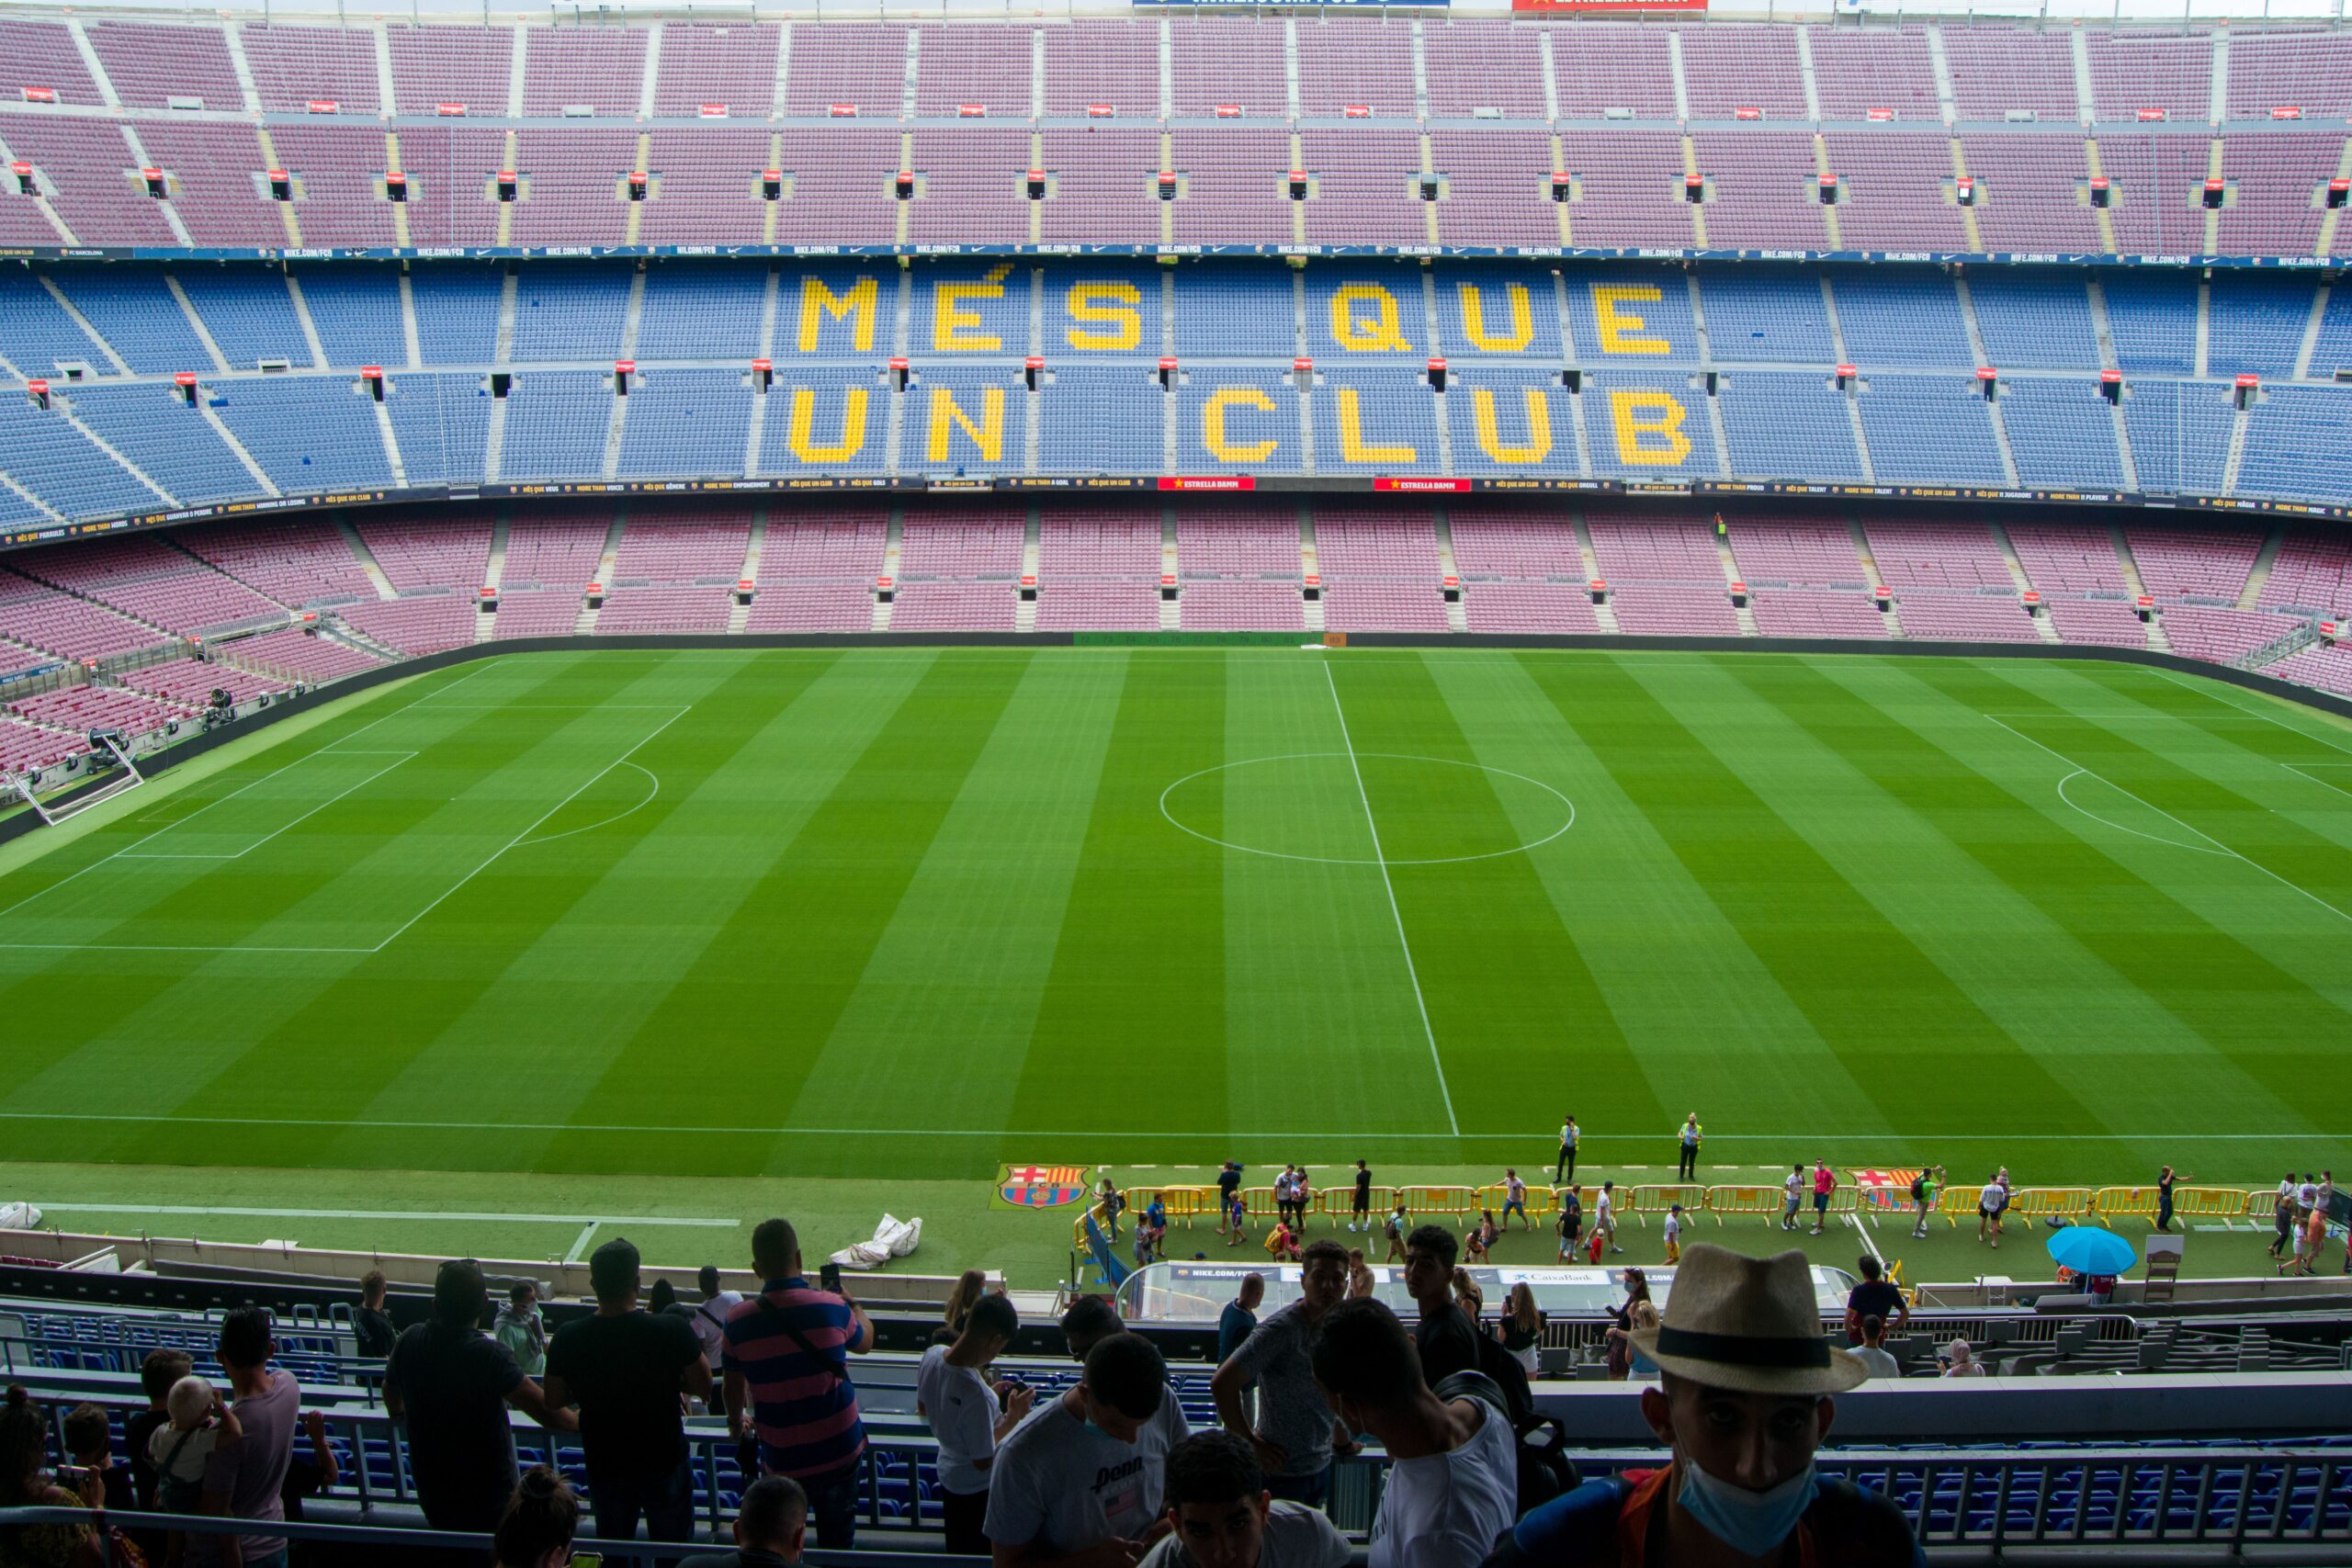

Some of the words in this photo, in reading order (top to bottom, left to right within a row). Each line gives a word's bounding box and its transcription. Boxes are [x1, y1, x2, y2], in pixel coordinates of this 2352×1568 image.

[417, 248, 464, 257] NIKE.COM/FCB
[547, 247, 591, 255] NIKE.COM/FCB
[1158, 245, 1201, 253] NIKE.COM/FCB
[1278, 245, 1321, 253] NIKE.COM/FCB
[1398, 246, 1442, 254] NIKE.COM/FCB
[1519, 247, 1562, 255] NIKE.COM/FCB
[1761, 250, 1806, 258] NIKE.COM/FCB
[2011, 254, 2057, 262] NIKE.COM/FCB
[2141, 255, 2189, 264] NIKE.COM/FCB
[797, 263, 1141, 352] MÉS
[1329, 283, 1671, 354] QUE
[786, 386, 1005, 463] UN
[1204, 386, 1692, 466] CLUB
[194, 508, 212, 516] PERDRE
[82, 525, 96, 533] MORE
[111, 520, 128, 529] WORDS
[1531, 1273, 1592, 1281] CaixaBank
